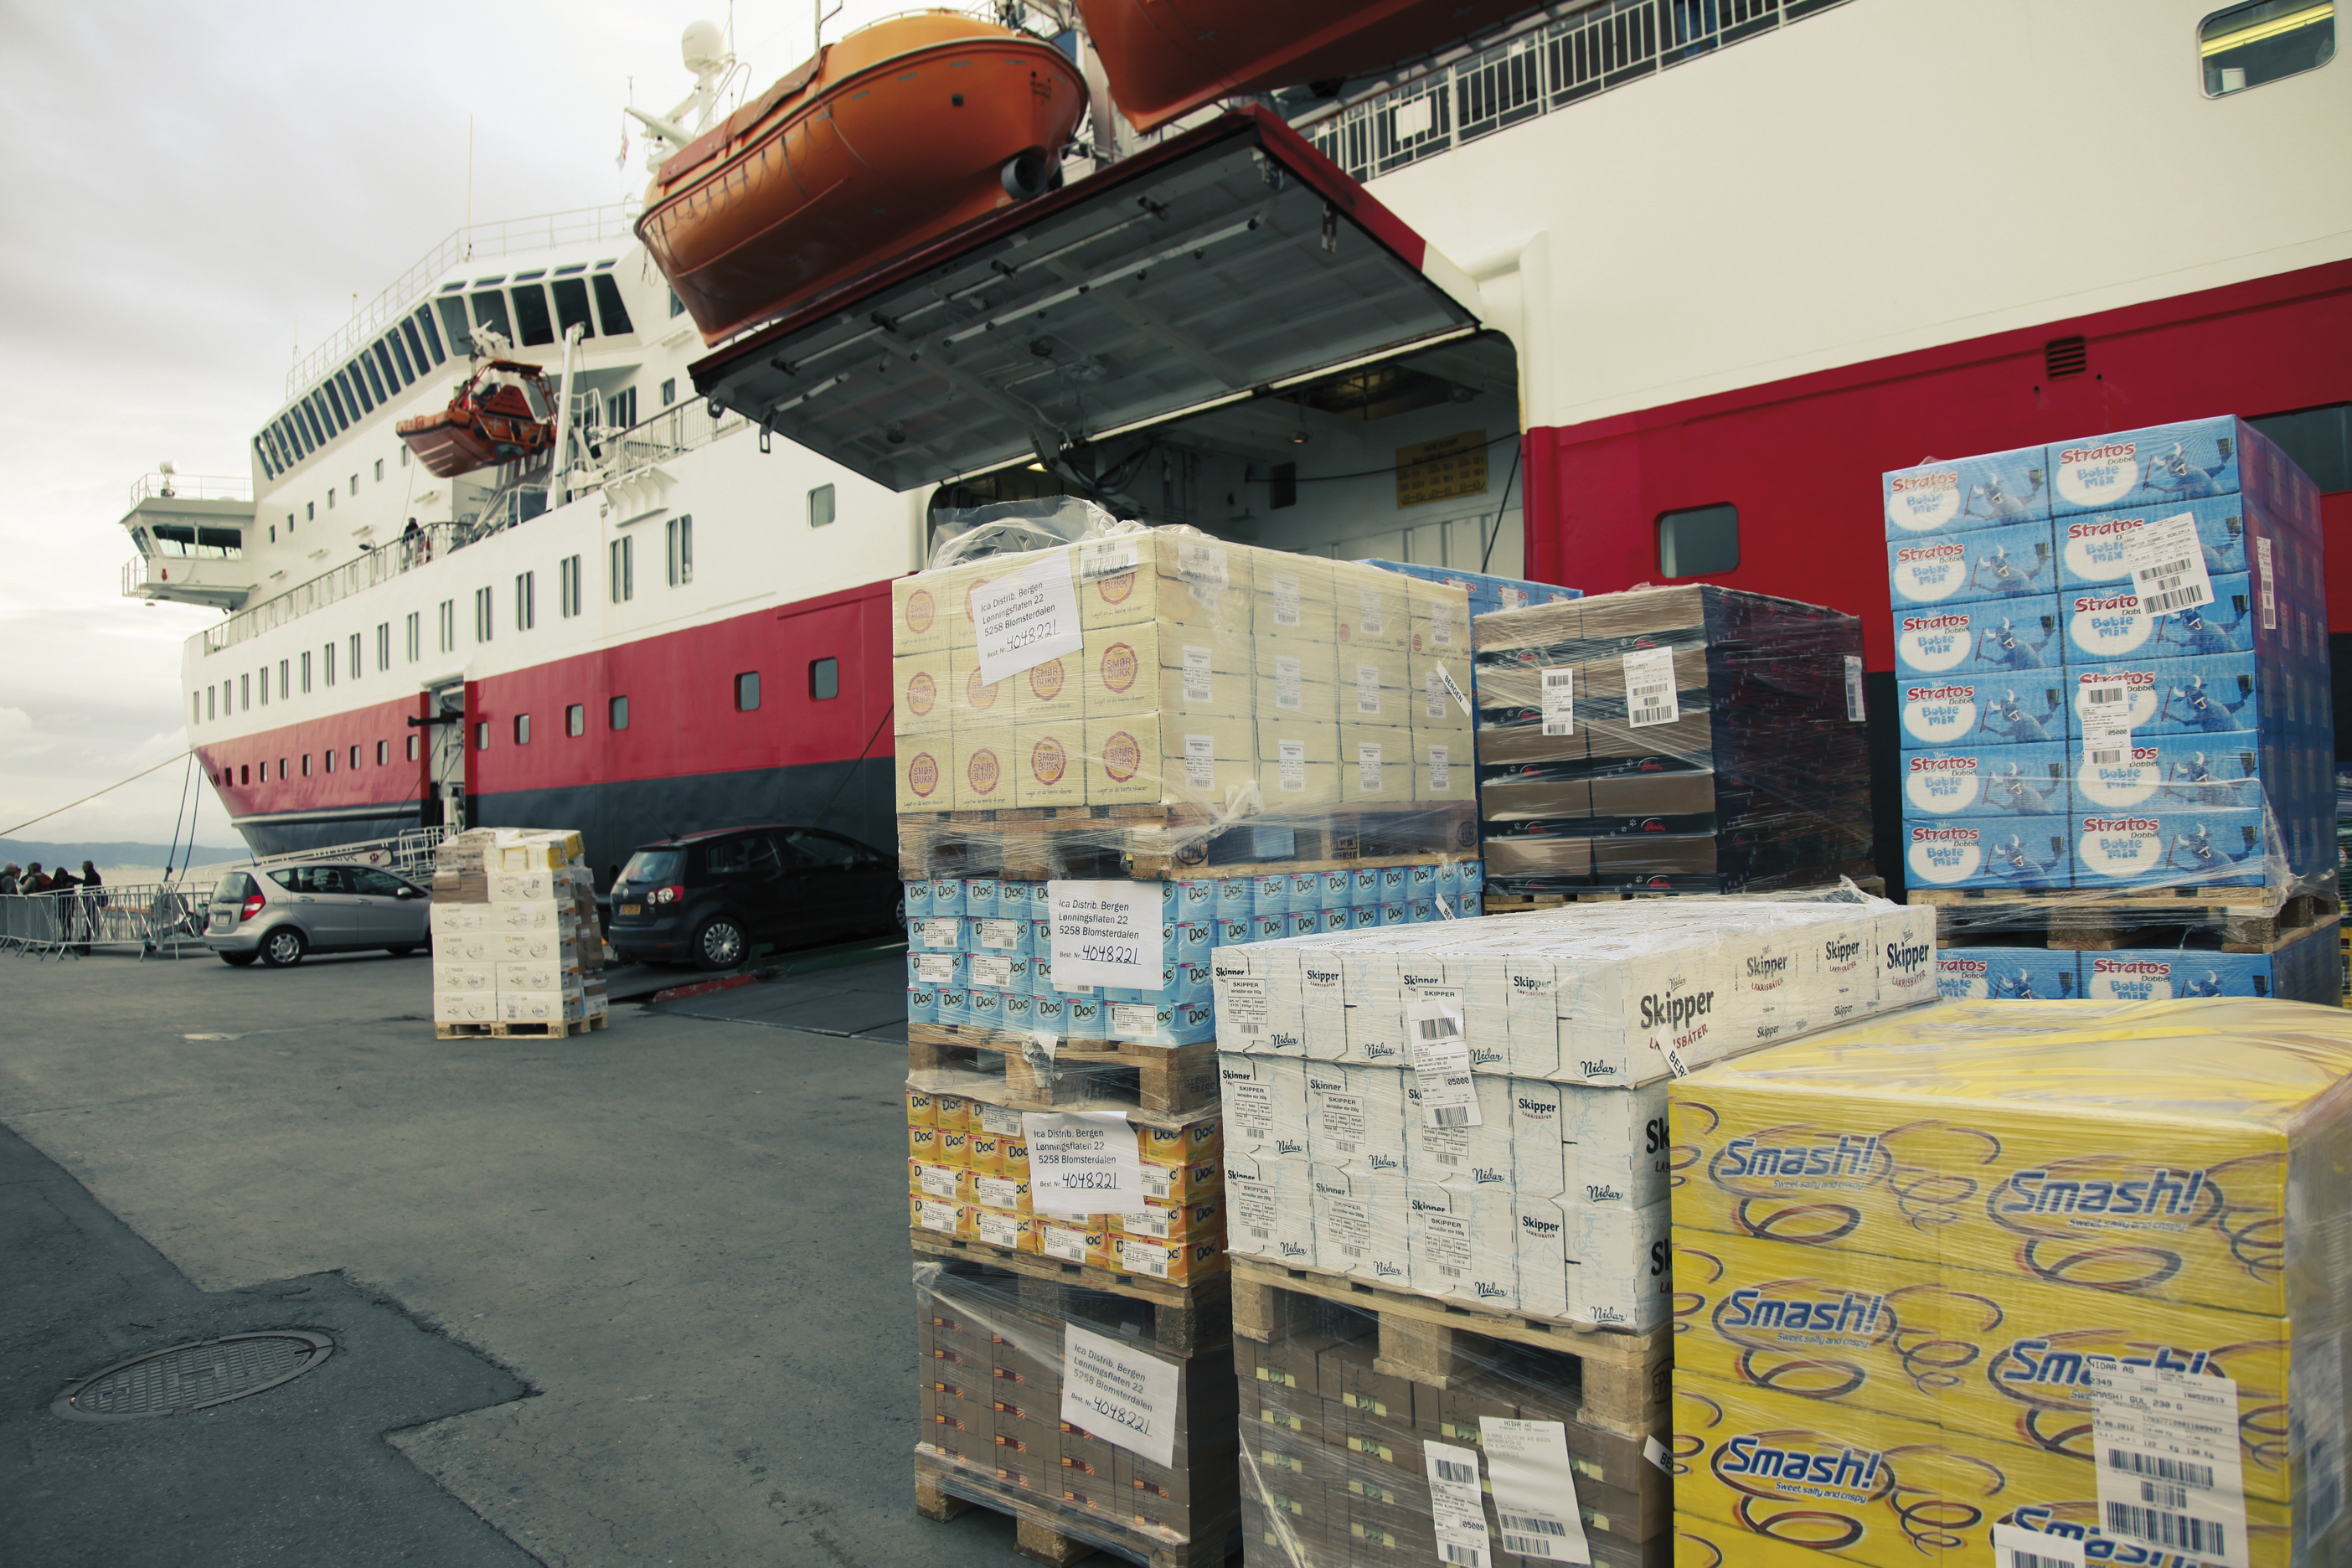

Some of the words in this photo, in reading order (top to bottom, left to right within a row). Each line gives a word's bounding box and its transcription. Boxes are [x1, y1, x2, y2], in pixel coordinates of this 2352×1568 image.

[2060, 442, 2136, 465] Stratos
[2107, 455, 2136, 465] Dobbel
[2077, 465, 2119, 480] Boble
[1891, 472, 1957, 492] Stratos
[1897, 544, 1964, 562] Stratos
[1912, 565, 1949, 578] Boble
[982, 604, 991, 612] Ica
[993, 593, 1016, 607] Distrib.
[1019, 582, 1043, 597] Bergen
[2075, 594, 2138, 612] Strato
[983, 599, 1032, 624] Lønningsflaten
[1034, 594, 1044, 604] 22
[985, 623, 1003, 637] 5258
[1005, 605, 1055, 629] Blomsterdalen
[1903, 614, 1969, 632] Stratos
[2092, 616, 2133, 629] Boble
[1007, 619, 1056, 649] 4048221
[1945, 627, 1969, 635] Dobbel
[1918, 634, 1954, 647] Boble
[1106, 658, 1131, 668] SMØR
[1107, 668, 1131, 678] BUKK
[1444, 675, 1463, 703] BERGEN
[1906, 685, 1974, 701] Stratos
[1921, 706, 1959, 717] Boble
[1037, 752, 1060, 762] SMØR
[1910, 756, 1977, 771] Stratos
[914, 766, 933, 776] SMØR
[973, 763, 995, 773] SMØR
[1038, 761, 1060, 771] BUKK
[915, 774, 932, 784] BUKK
[973, 772, 994, 781] BUKK
[2083, 818, 2159, 833] Stratos
[1911, 828, 1978, 842] Stratos
[1073, 900, 1098, 909] Distrib.
[1101, 901, 1129, 912] Bergen
[1059, 913, 1115, 924] Lønningsflaten
[1117, 916, 1127, 924] 22
[1060, 926, 1080, 935] 5258
[1083, 927, 1139, 939] Blomsterdalen
[1082, 945, 1137, 964] 4048221
[1826, 940, 1860, 965] Skipper
[1887, 942, 1929, 973] Skipper
[1746, 955, 1787, 983] Skipper
[1829, 960, 1857, 973] LAKRISBÅTER
[2093, 958, 2170, 975] Stratos
[1307, 970, 1339, 983] Skipper
[1514, 975, 1551, 990] Skipper
[1669, 974, 1686, 992] Nidar
[1751, 976, 1784, 992] LAKRISBÅTER
[1891, 969, 1926, 988] LAKRISBÅTER
[2110, 980, 2153, 993] Boble
[1641, 991, 1714, 1032] Skipper
[1757, 1024, 1780, 1039] Skipper
[1271, 1033, 1298, 1048] Nidar
[1469, 1048, 1503, 1065] Nidar
[1669, 1050, 1688, 1077] BER
[1581, 1060, 1617, 1077] Nidar
[1447, 1076, 1469, 1086] 05000
[1519, 1098, 1556, 1114] Skipper
[1076, 1129, 1104, 1138] Bergen
[1036, 1142, 1091, 1152] Lønningsflaten
[1094, 1142, 1104, 1150] 22
[1039, 1155, 1059, 1163] 5258
[1062, 1155, 1116, 1163] Blomsterdalen
[1369, 1155, 1398, 1169] Nidar
[1720, 1136, 1878, 1176] Smash!
[1063, 1172, 1116, 1189] 4048221
[1586, 1184, 1623, 1203] Nidar
[2001, 1169, 2205, 1215] Smash!
[1431, 1218, 1462, 1228] SKIPPER
[1523, 1216, 1560, 1233] Skipper
[1591, 1307, 1627, 1323] Nidar
[1725, 1290, 1884, 1333] Smash!
[1804, 1335, 1824, 1345] salty
[1844, 1339, 1869, 1348] crispy
[1075, 1344, 1086, 1355] Ica
[1088, 1350, 1114, 1369] Distrib.
[1117, 1363, 1146, 1381] Bergen
[2089, 1361, 2117, 1372] NIDAR
[1074, 1357, 1130, 1388] Lønningsflaten
[1132, 1383, 1143, 1394] 22
[2091, 1377, 2112, 1386] 2349
[1074, 1369, 1094, 1385] 5258
[1096, 1380, 1153, 1411] Blomsterdalen
[1071, 1393, 1084, 1403] Best.
[2091, 1390, 2122, 1400] SMASH!
[2129, 1396, 2147, 1406] GUL
[2153, 1400, 2171, 1409] 230
[1094, 1396, 1150, 1434] 4048221
[2169, 1445, 2179, 1453] Kg
[1722, 1436, 1881, 1488] Smash!
[1803, 1487, 1822, 1497] salty
[1841, 1493, 1867, 1504] crispy
[1462, 1520, 1485, 1531] 05000
